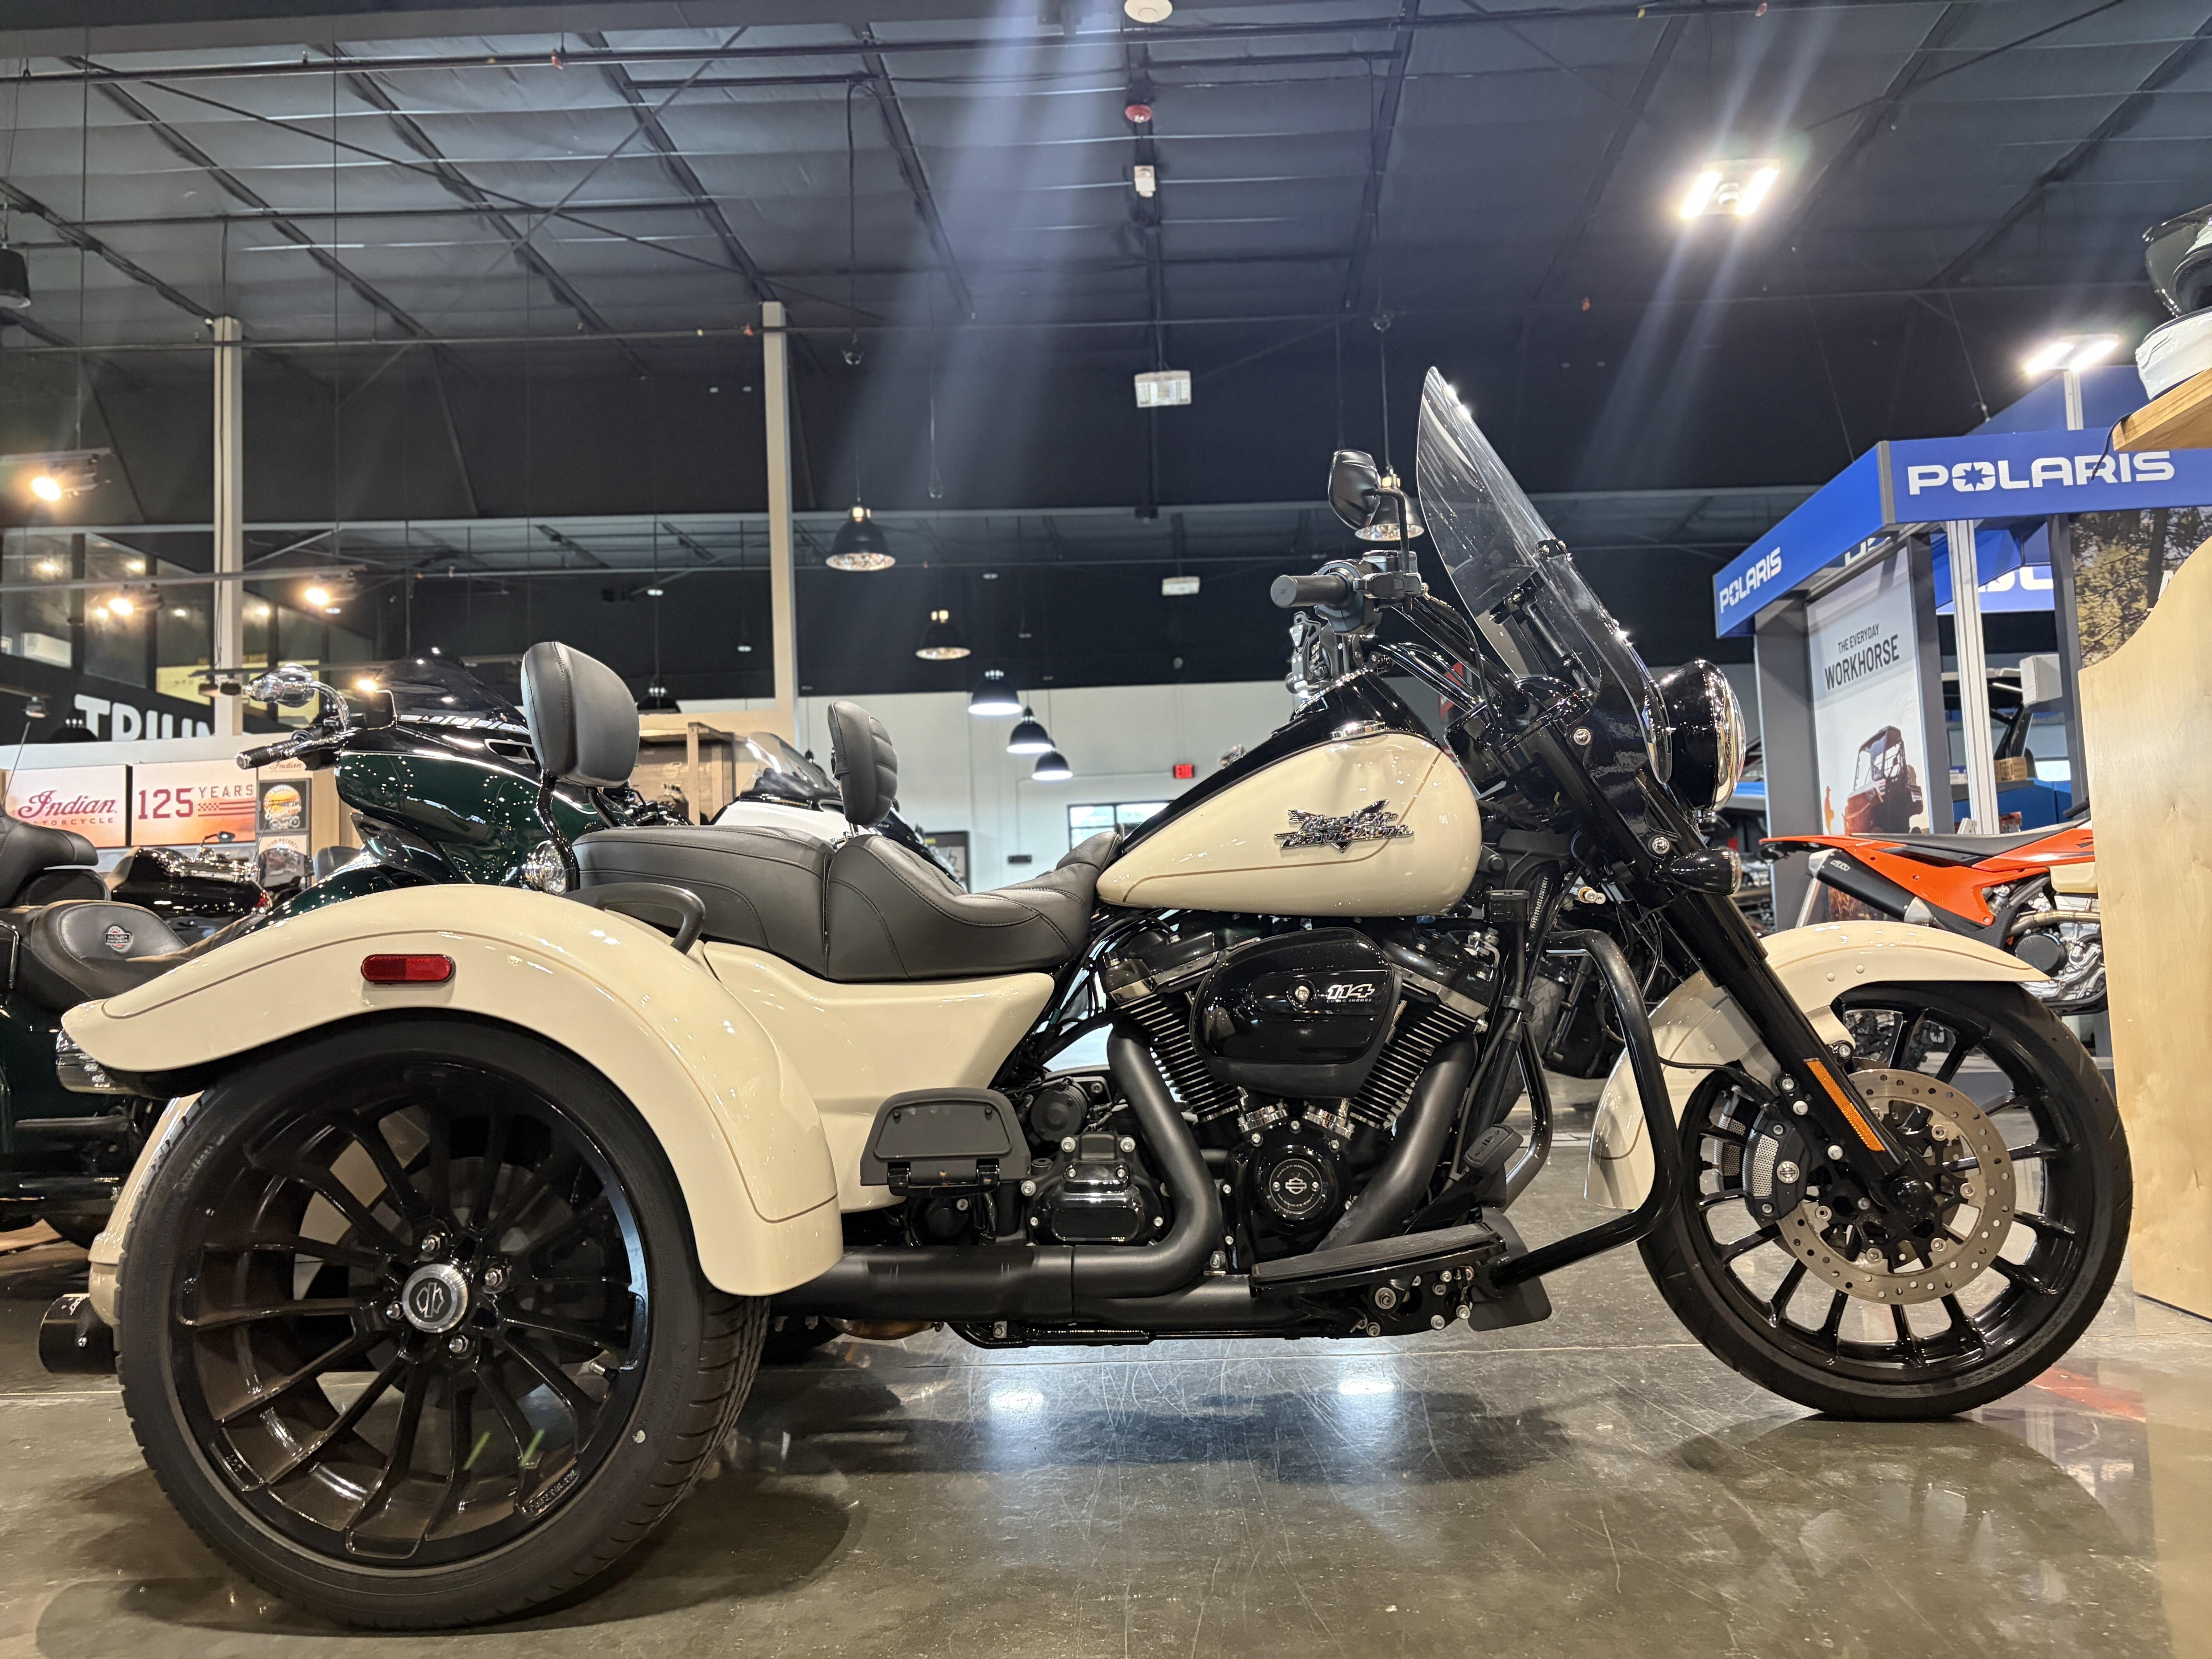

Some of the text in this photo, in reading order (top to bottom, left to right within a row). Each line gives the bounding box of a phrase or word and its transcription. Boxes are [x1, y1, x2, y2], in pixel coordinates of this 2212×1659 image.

[1908, 451, 2175, 495] POLARIS
[1719, 546, 1782, 614] POLARIS
[1838, 623, 1879, 654] THE EVERYDAY
[1824, 634, 1899, 690] WORKHORSE
[18, 790, 116, 818] Indian
[138, 784, 254, 820] 125 YEARS
[33, 817, 113, 826] OTORCYCLE
[1327, 984, 1375, 1000] 114
